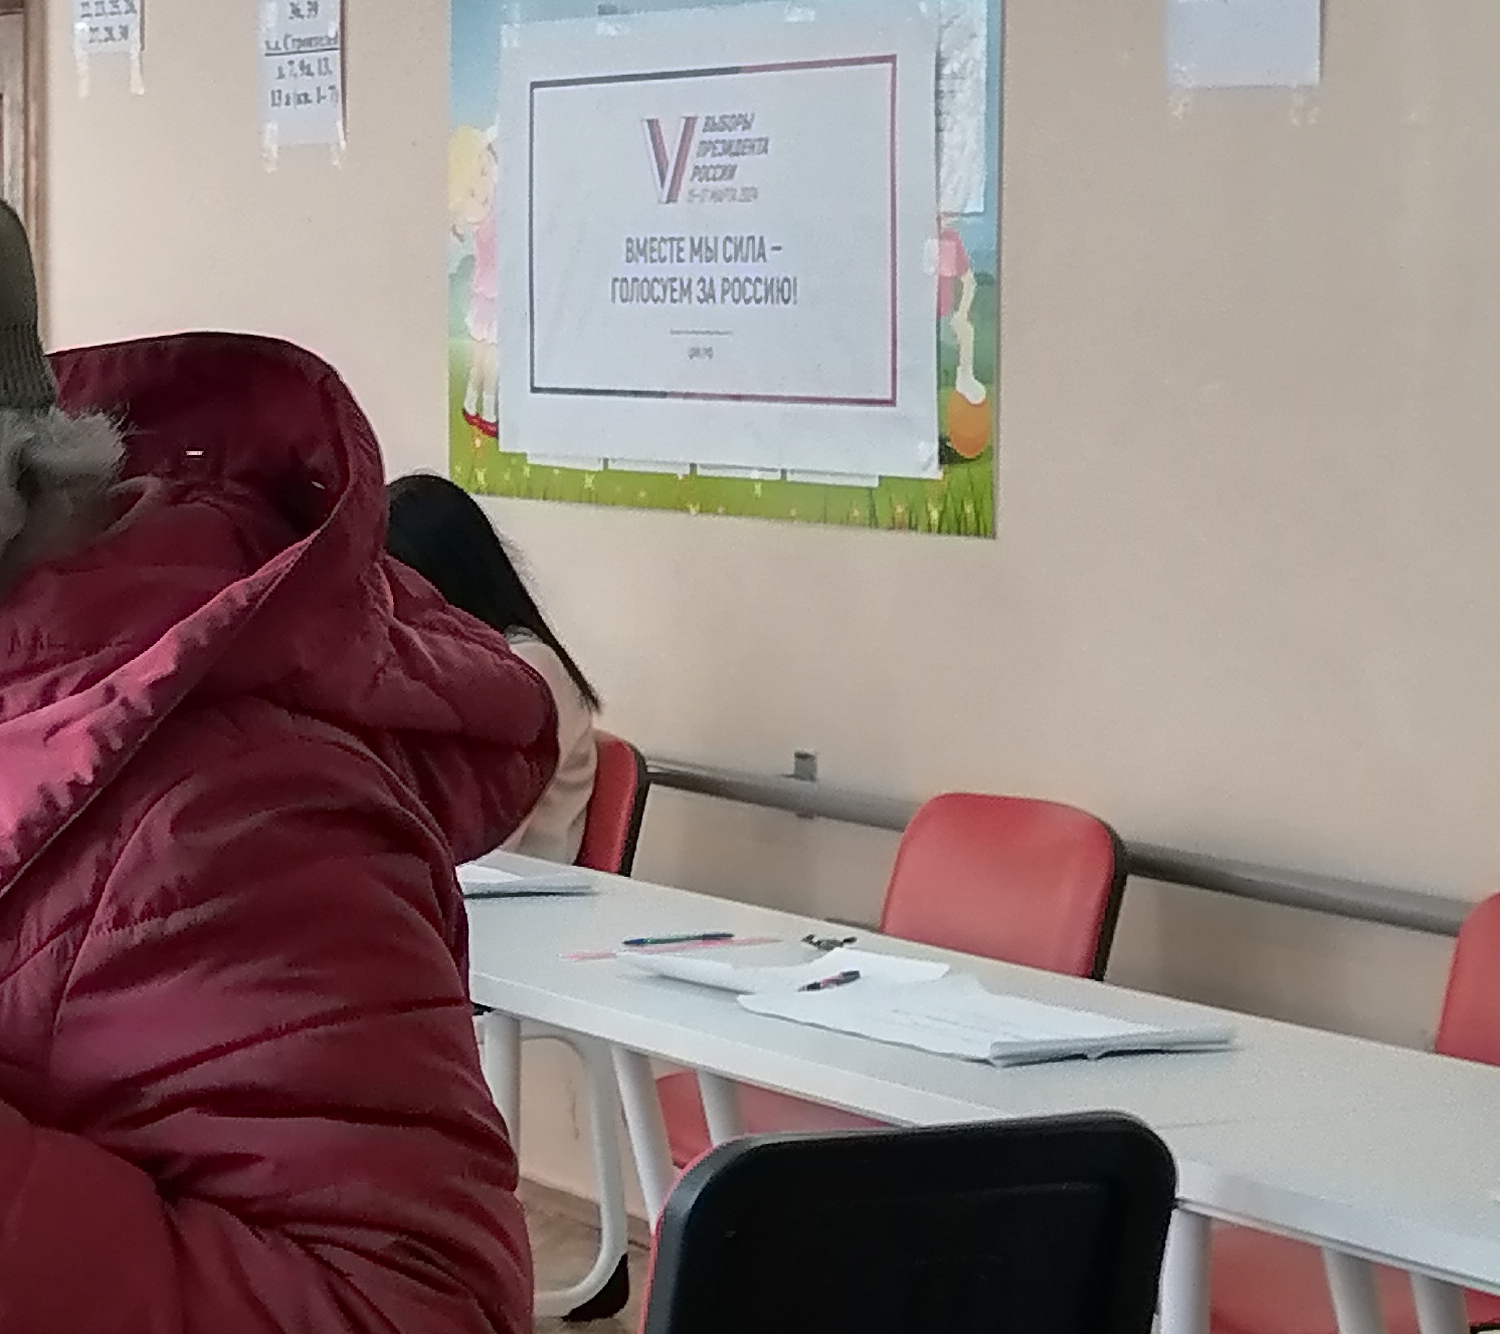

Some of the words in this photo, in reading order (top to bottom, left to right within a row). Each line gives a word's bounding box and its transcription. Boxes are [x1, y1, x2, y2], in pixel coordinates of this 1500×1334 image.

[625, 236, 686, 264] ВМЕСТЕ
[689, 235, 718, 264] МЫ
[722, 235, 767, 263] СИЛА
[610, 276, 692, 304] ГОЛОСУЕМ
[696, 276, 716, 304] ЗА
[720, 276, 798, 305] РОССИЮ!
